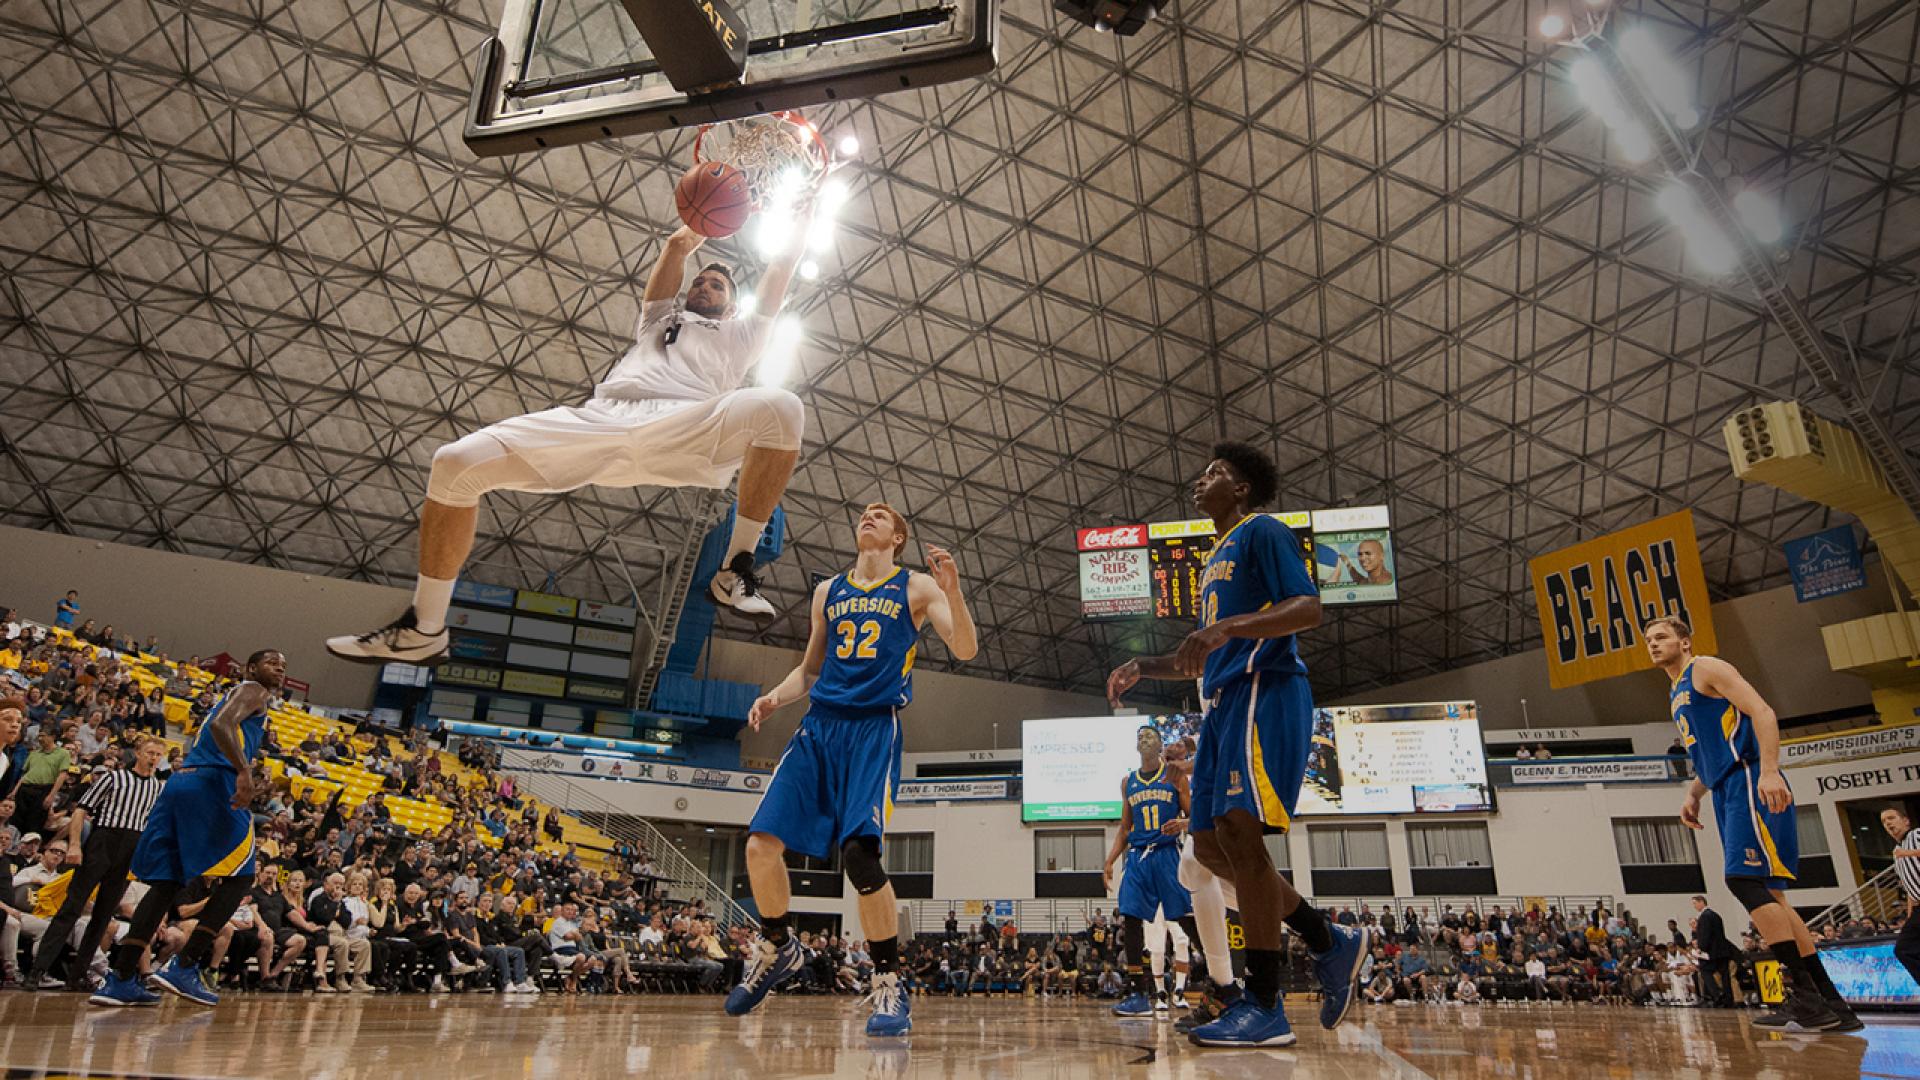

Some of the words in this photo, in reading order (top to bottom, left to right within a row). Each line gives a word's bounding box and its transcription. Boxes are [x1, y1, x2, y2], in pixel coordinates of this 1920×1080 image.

[1088, 550, 1140, 568] NAPLES
[1102, 562, 1128, 574] RIB
[1090, 569, 1140, 585] COMPANY
[826, 597, 903, 622] RIVERSIDE
[1545, 539, 1693, 665] BEACH
[836, 620, 881, 659] 32
[1517, 730, 1581, 739] WOMEN
[1787, 728, 1915, 757] COMMISSIONER'S
[968, 752, 995, 760] MEN
[1514, 766, 1555, 777] GLENN
[1558, 765, 1568, 775] E.
[1571, 764, 1621, 774] THOMAS
[898, 785, 920, 794] ENN
[933, 783, 972, 793] THOMAS
[1816, 768, 1893, 795] JOSEPH
[1142, 804, 1159, 831] 11
